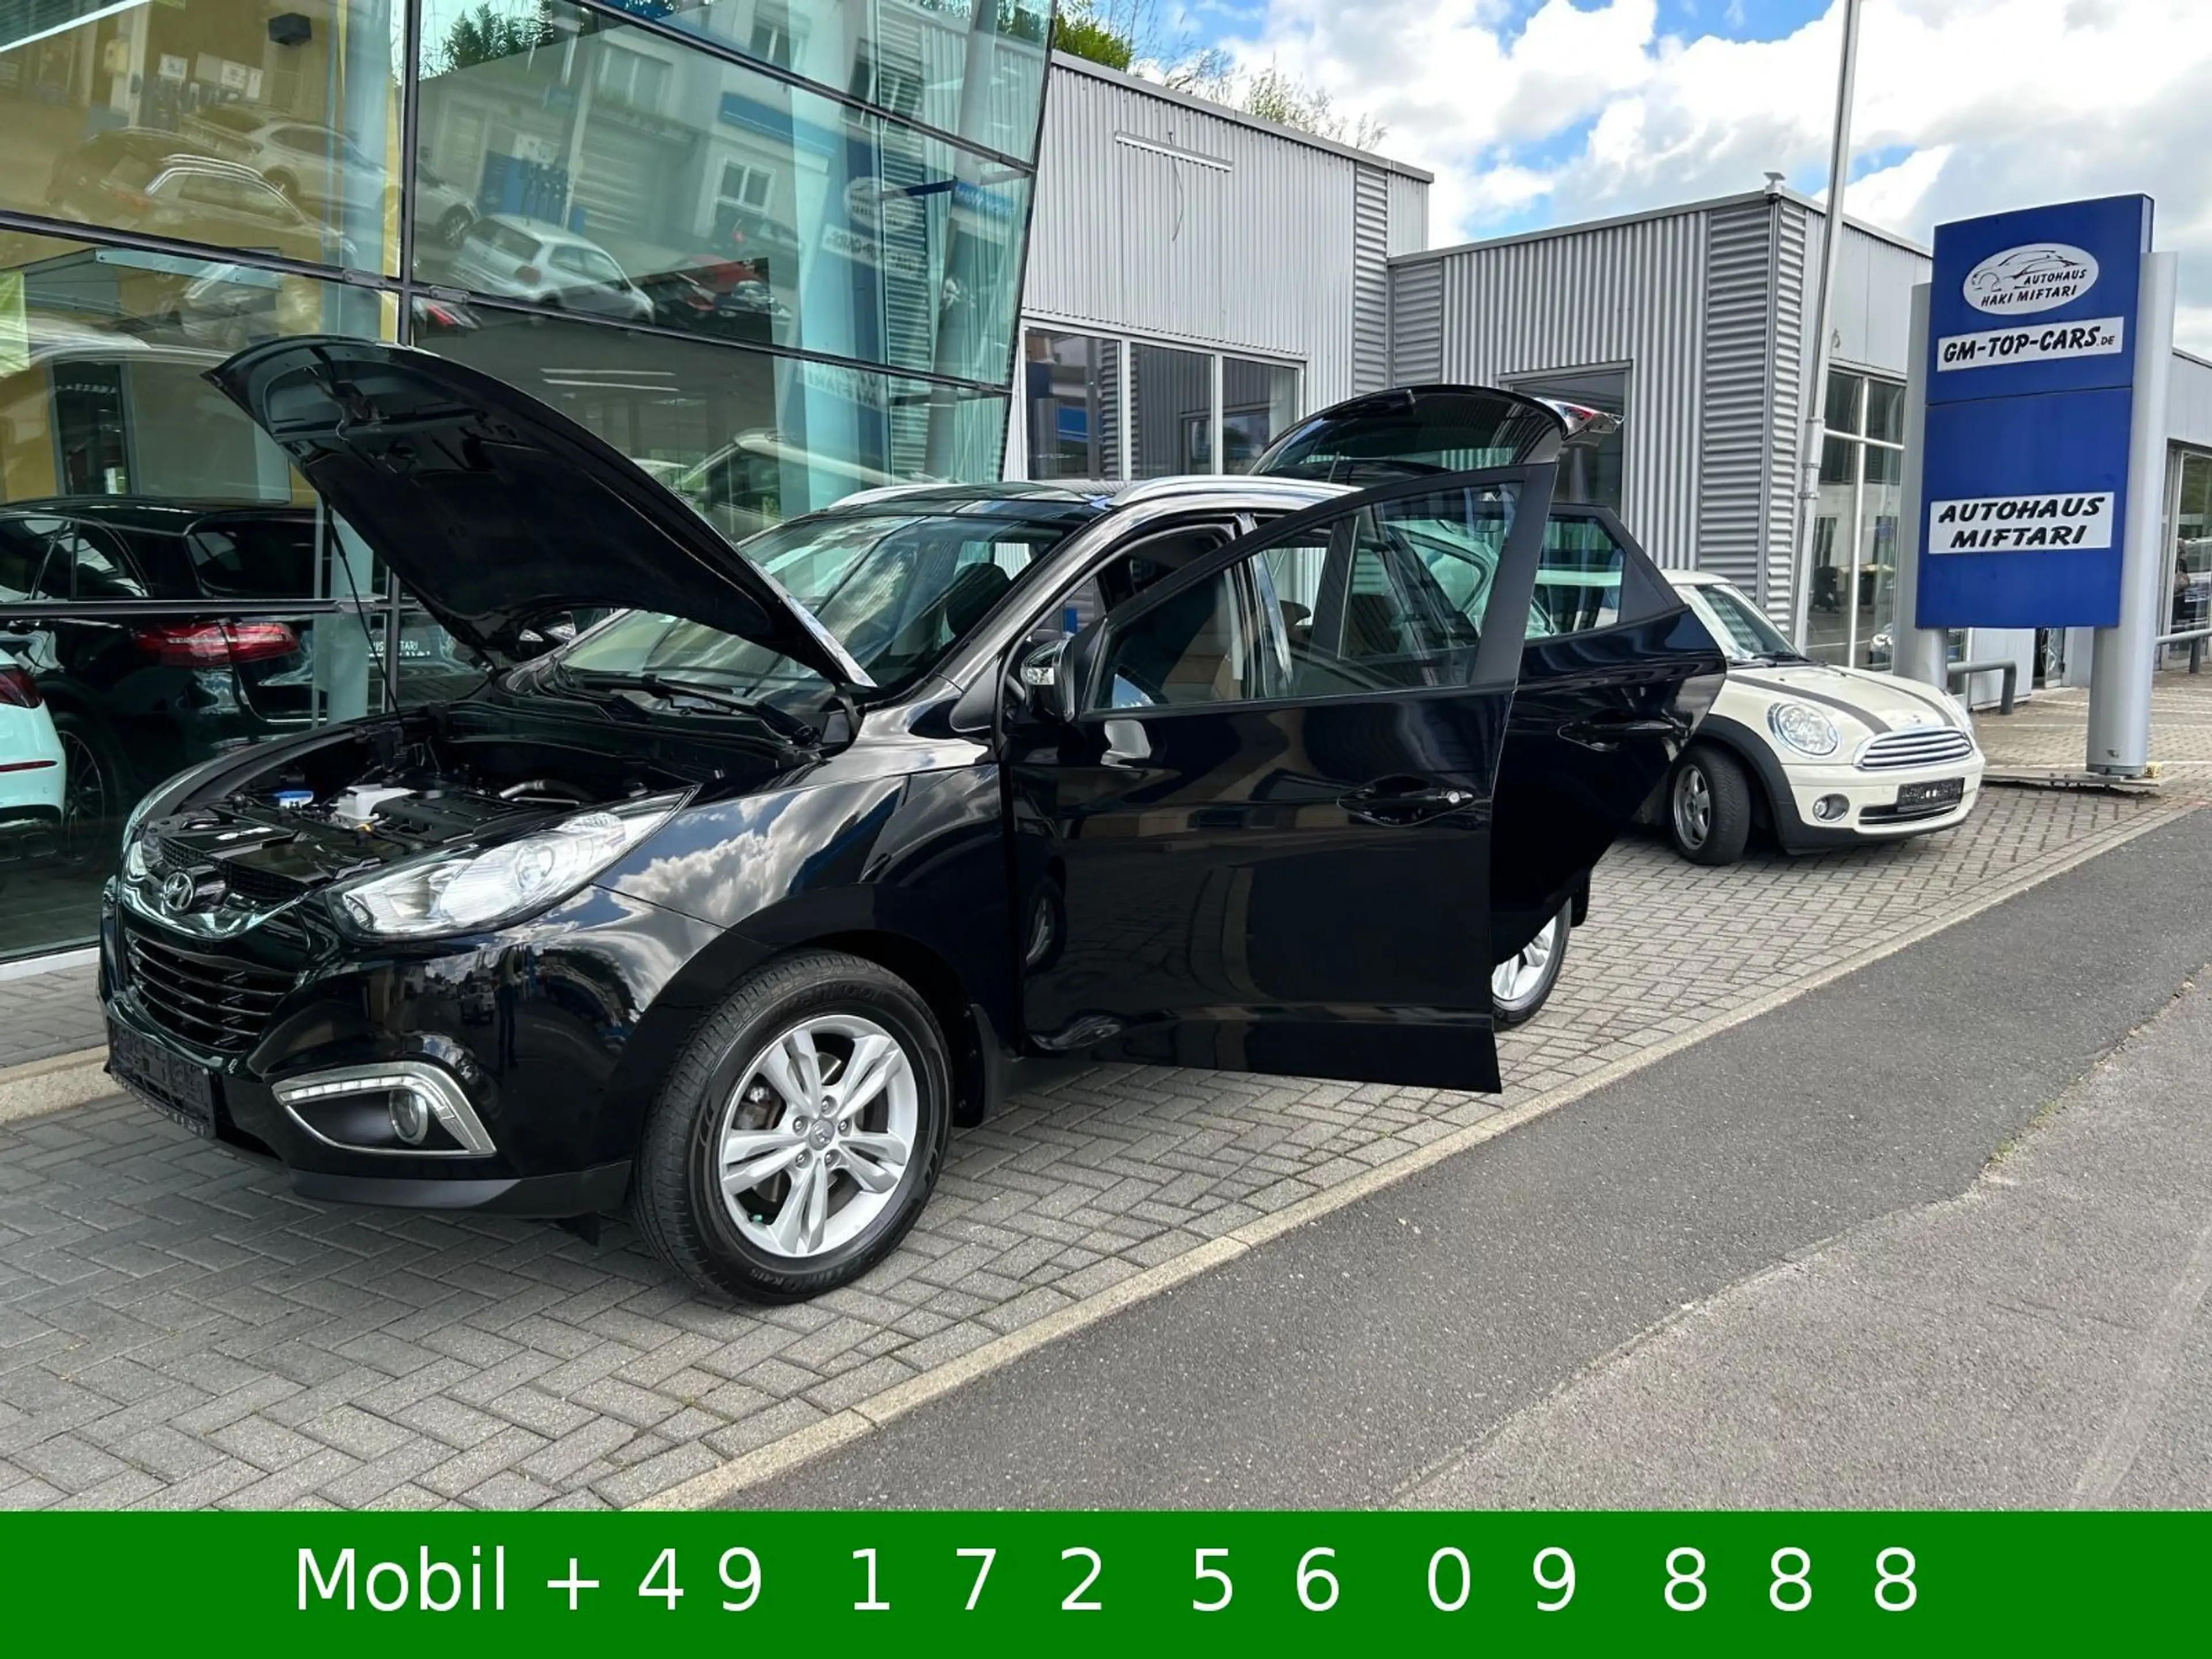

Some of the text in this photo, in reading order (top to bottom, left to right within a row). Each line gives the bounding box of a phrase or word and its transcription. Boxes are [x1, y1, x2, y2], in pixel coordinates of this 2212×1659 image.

[2024, 269, 2088, 286] AUTOHAUS
[1981, 285, 2078, 307] HAKI MIFTARI
[1937, 496, 2106, 523] AUTOHAUS
[1949, 524, 2088, 548] MIFTARI
